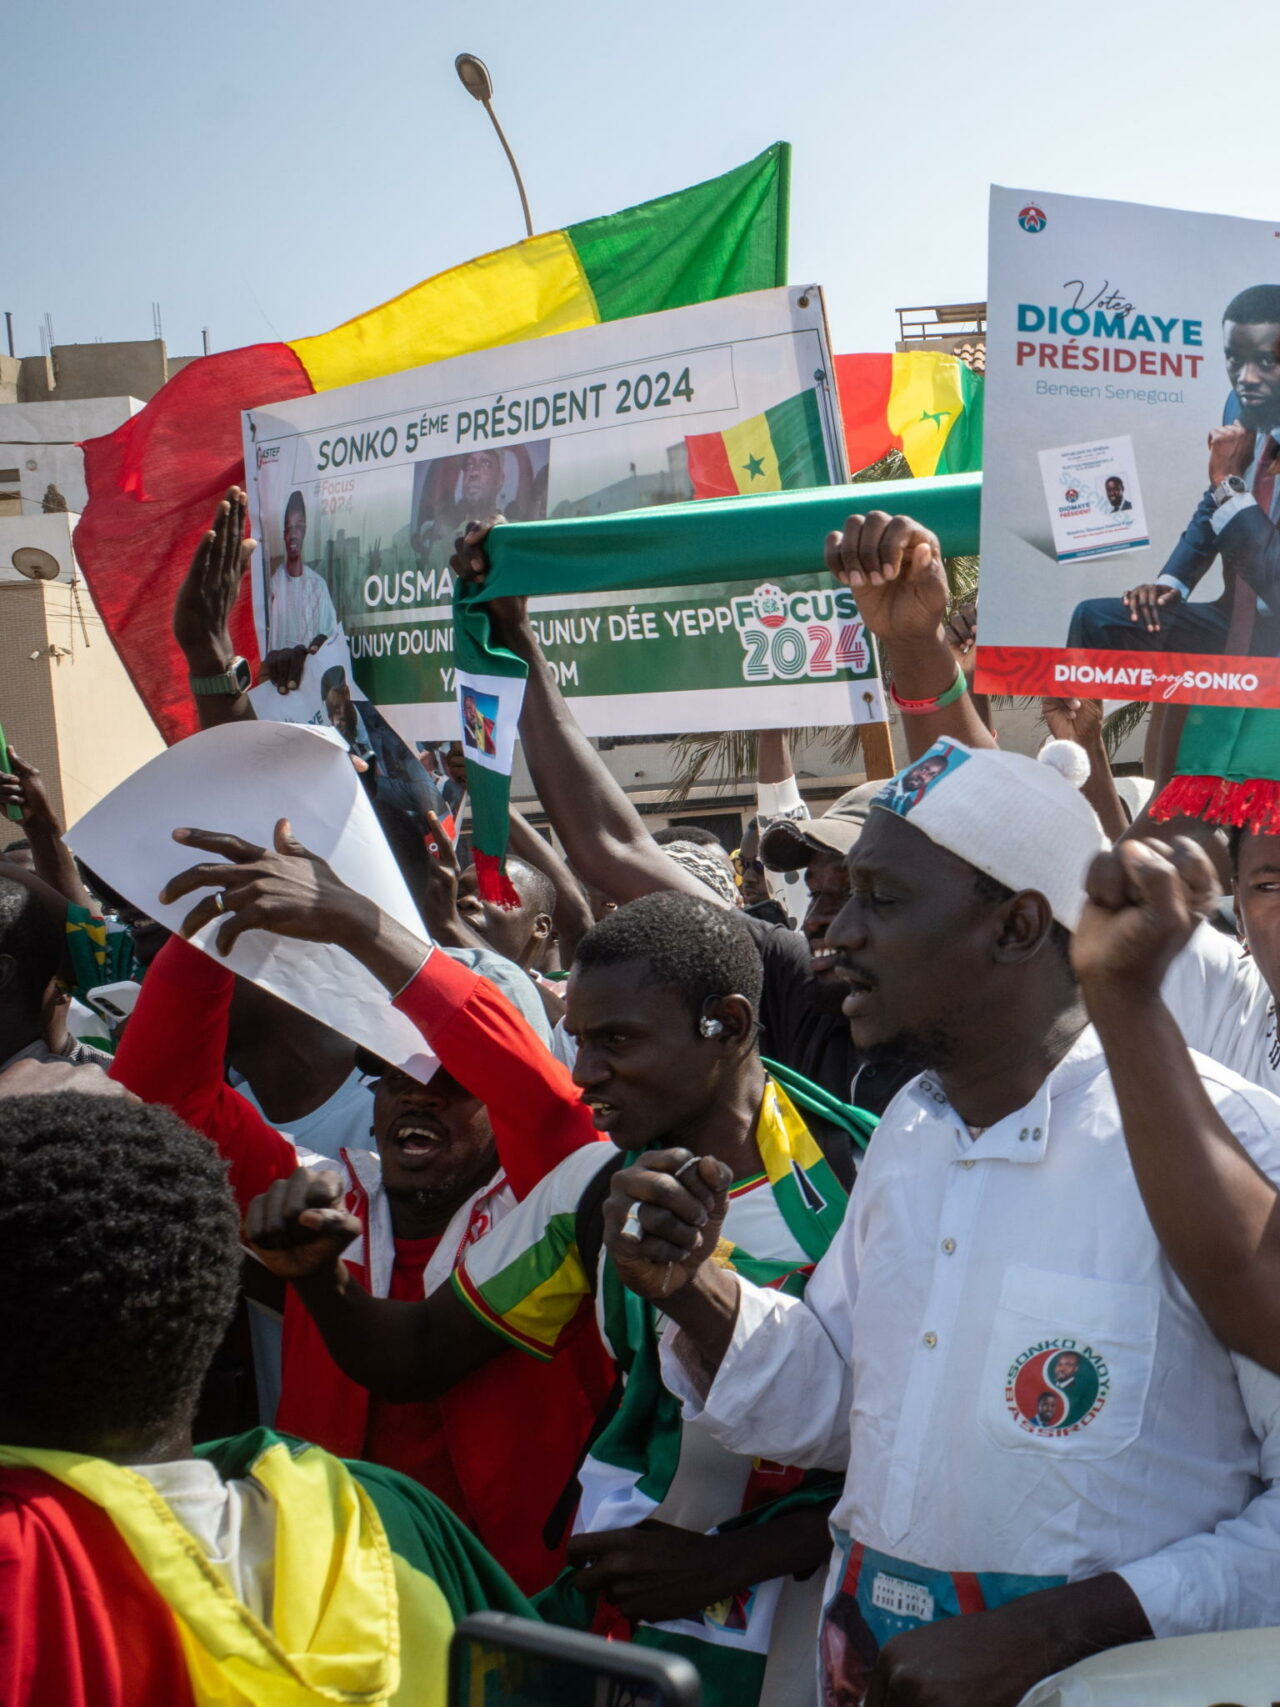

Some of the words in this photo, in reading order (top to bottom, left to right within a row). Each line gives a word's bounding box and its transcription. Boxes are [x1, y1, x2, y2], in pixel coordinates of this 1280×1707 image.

[1063, 280, 1136, 320] Votez
[1016, 303, 1203, 346] DIOMAYE
[1015, 338, 1204, 379] PRÉSIDENT
[1035, 380, 1101, 400] Beneen
[1104, 385, 1185, 405] Senegaal
[317, 426, 398, 471] SONKO
[456, 384, 607, 444] PRÉSIDENT
[615, 367, 694, 414] 2024
[364, 567, 454, 607] OUSMA
[346, 632, 395, 659] UNUY
[608, 605, 660, 641] DÉE
[744, 624, 866, 676] 2024
[1054, 664, 1152, 686] DIOMAYE
[1182, 670, 1258, 691] SONKO
[1007, 1338, 1076, 1378] SONKO
[1083, 1346, 1110, 1391] MOY
[1005, 1386, 1105, 1437] BASSIROU
